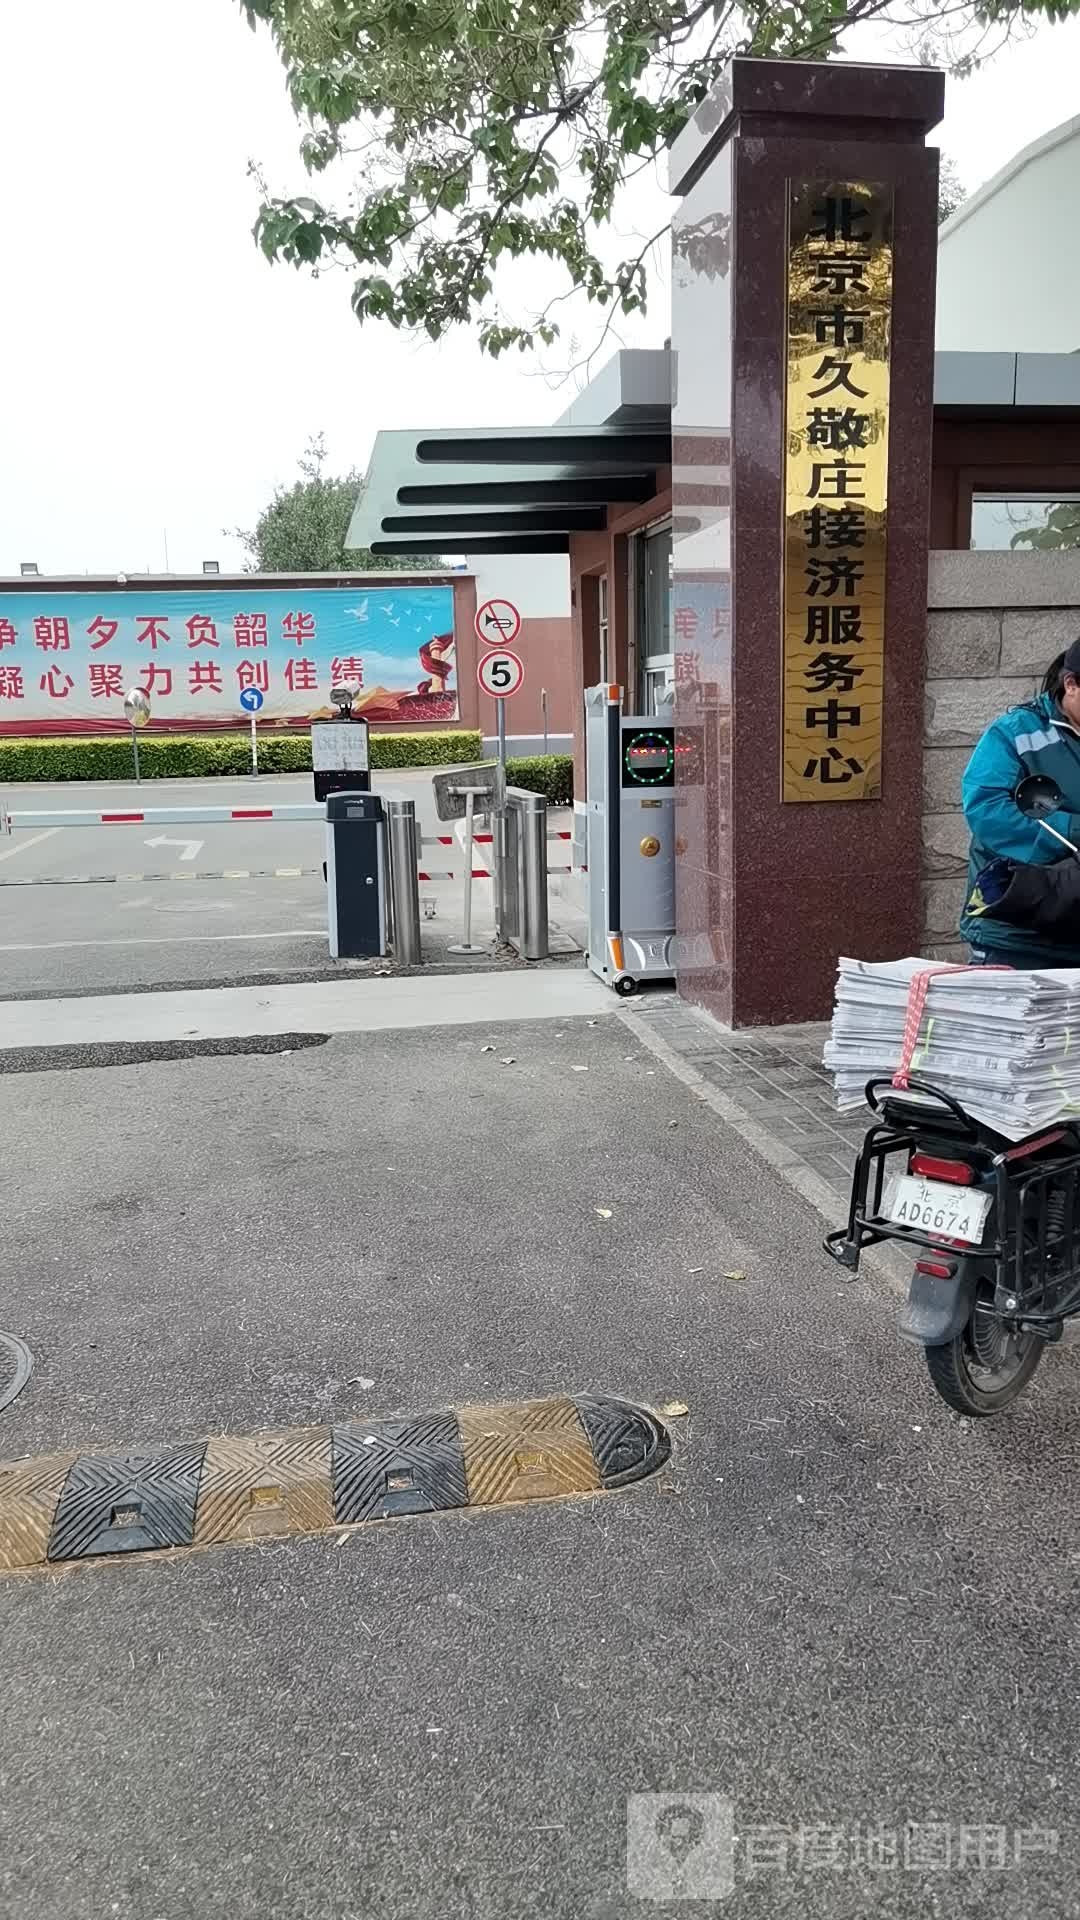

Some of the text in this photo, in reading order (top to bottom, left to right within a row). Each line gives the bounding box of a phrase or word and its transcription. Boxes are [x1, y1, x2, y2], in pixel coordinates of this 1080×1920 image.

[803, 197, 871, 784] 北京市久敬庄接济服务中心
[491, 660, 511, 687] 5
[898, 1200, 970, 1235] AD6674
